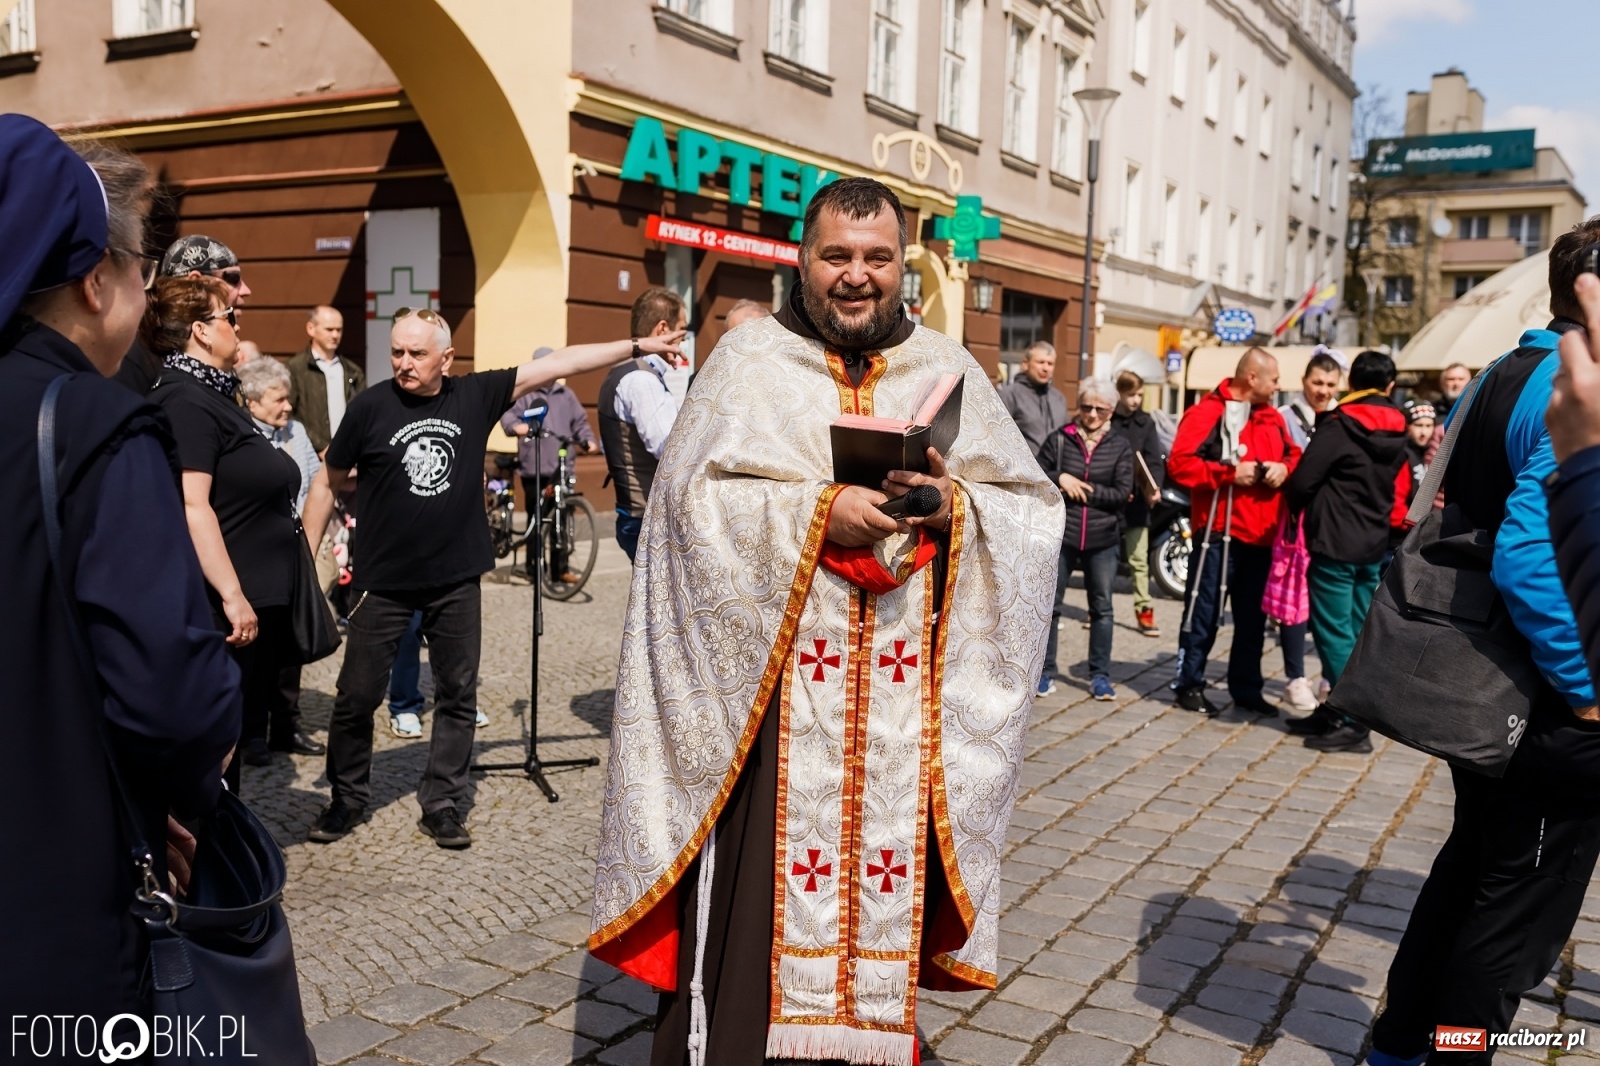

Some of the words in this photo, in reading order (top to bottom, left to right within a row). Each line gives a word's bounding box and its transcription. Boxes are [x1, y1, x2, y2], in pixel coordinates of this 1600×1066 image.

[619, 116, 839, 221] APTEK
[1405, 144, 1492, 162] McDonald's
[658, 221, 701, 243] RYNEK
[702, 229, 718, 247] 12
[723, 234, 775, 257] CENTRUM
[775, 244, 799, 263] FARM
